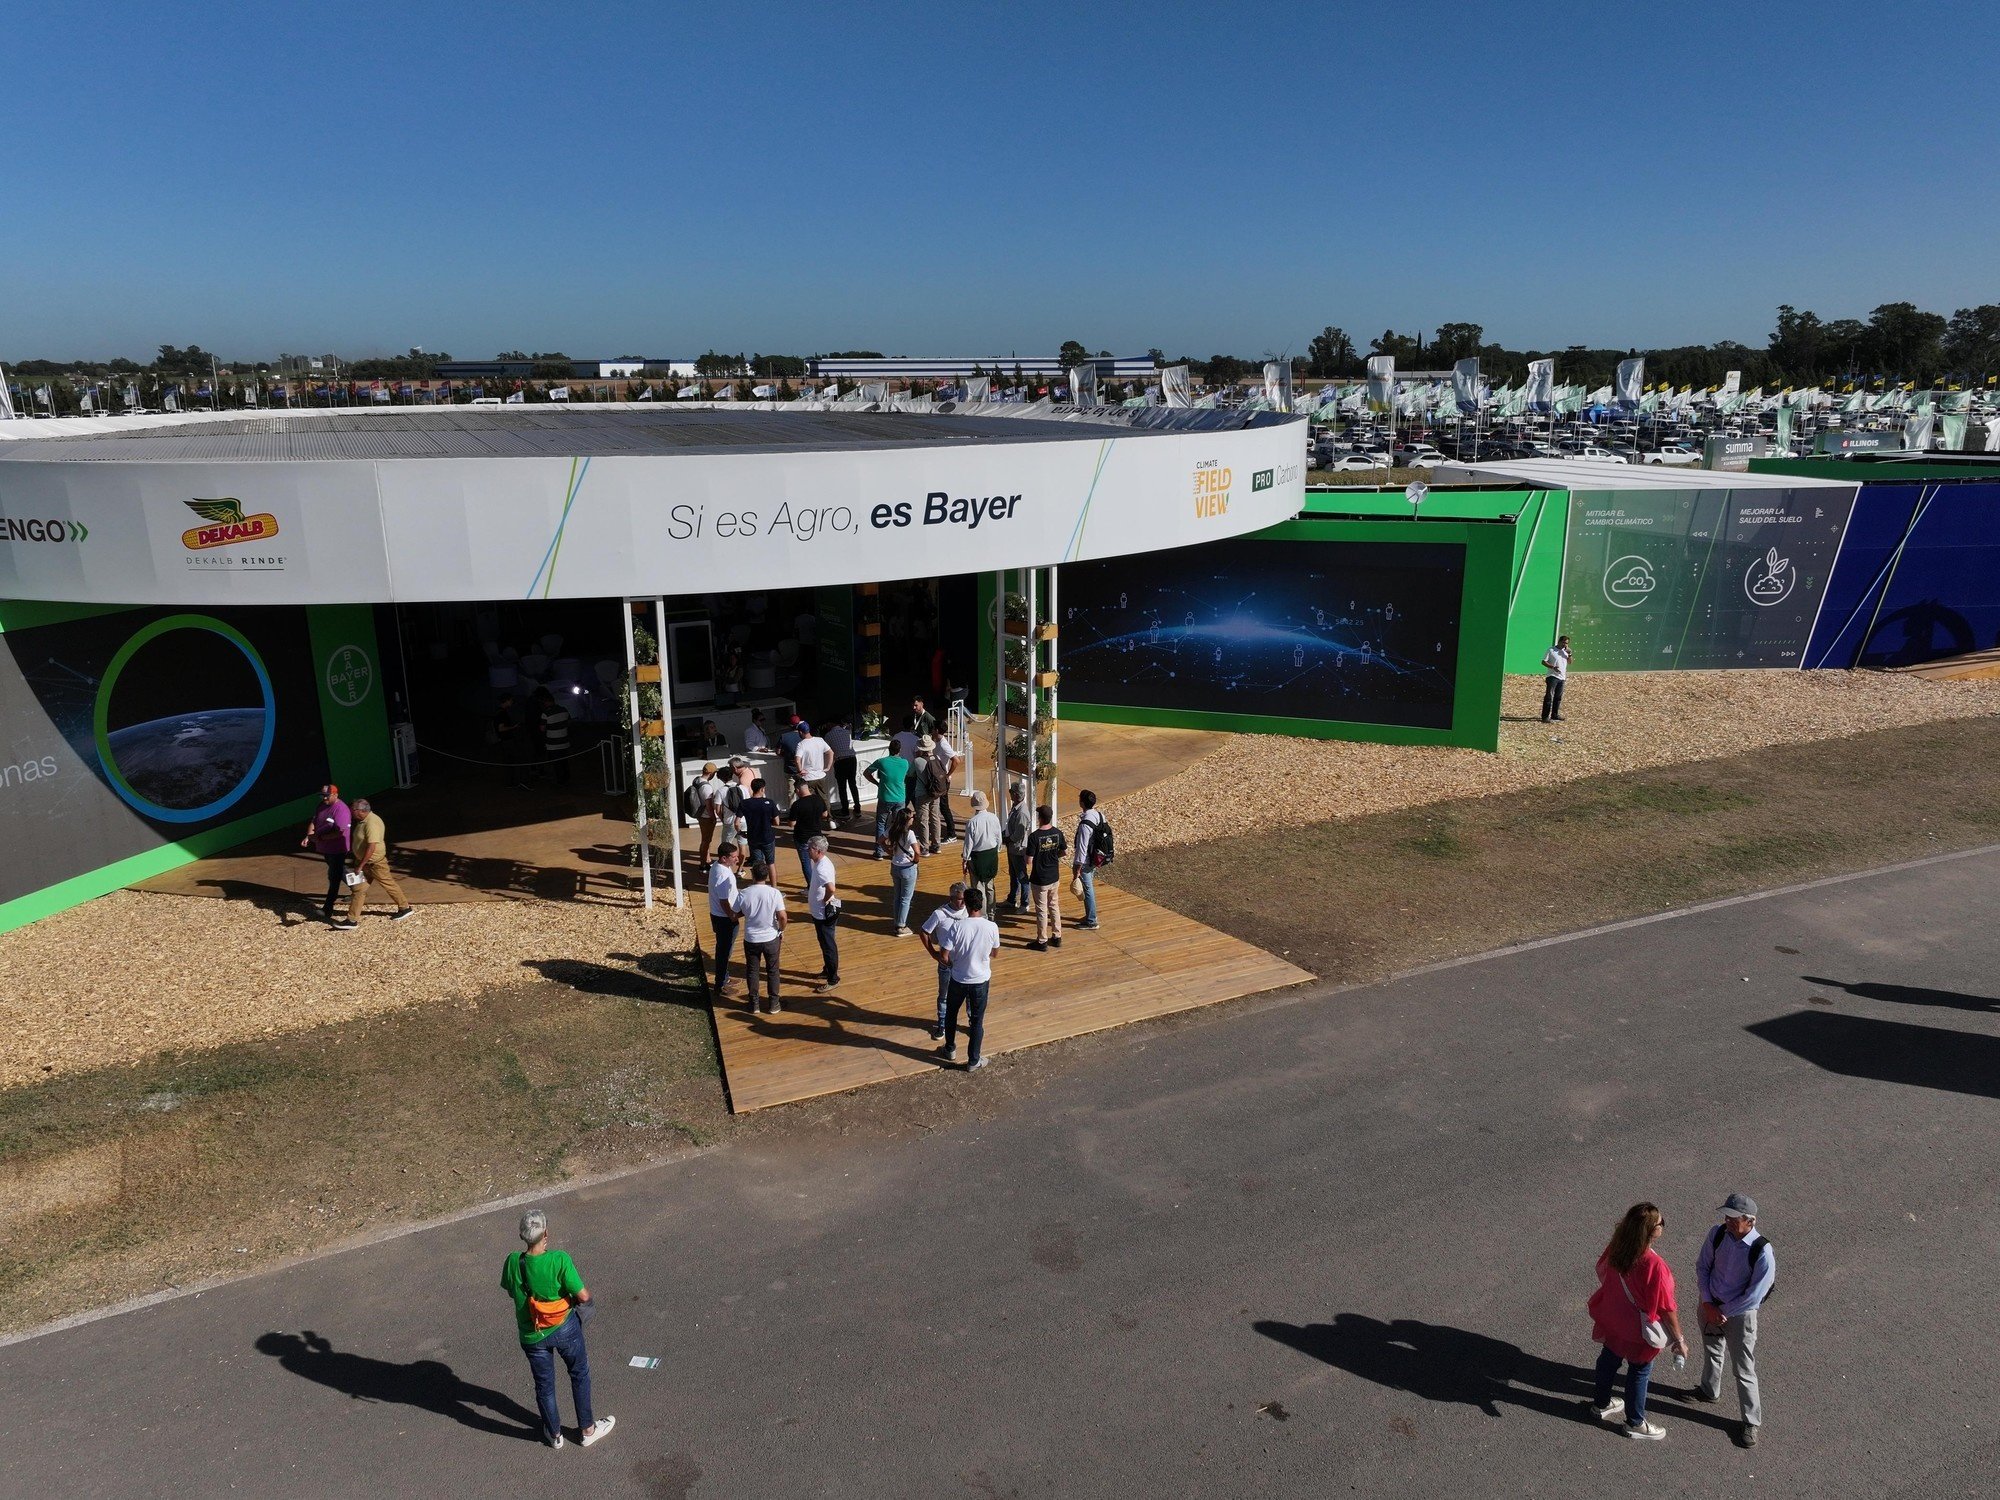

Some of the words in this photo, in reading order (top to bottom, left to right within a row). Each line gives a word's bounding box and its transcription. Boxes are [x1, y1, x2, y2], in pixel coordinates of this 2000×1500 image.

[1725, 442, 1753, 454] summa
[1850, 439, 1879, 447] ILLINOIS
[1196, 459, 1218, 469] CLIMATE
[1196, 468, 1232, 494] FIELD
[1255, 471, 1271, 489] PRO
[1195, 493, 1230, 519] VIEW
[1616, 509, 1626, 517] EL
[668, 504, 704, 540] Si
[716, 511, 758, 538] es
[767, 501, 859, 542] Agro,
[870, 502, 912, 529] es
[923, 491, 1022, 530] Bayer
[1585, 518, 1614, 526] CAMBIO
[1615, 517, 1654, 525] CLIMÁTICO
[1778, 515, 1803, 523] SUELO
[198, 520, 264, 545] DEKALB
[186, 556, 233, 565] DEKALB
[331, 667, 368, 685] BAYER
[0, 755, 58, 789] nas
